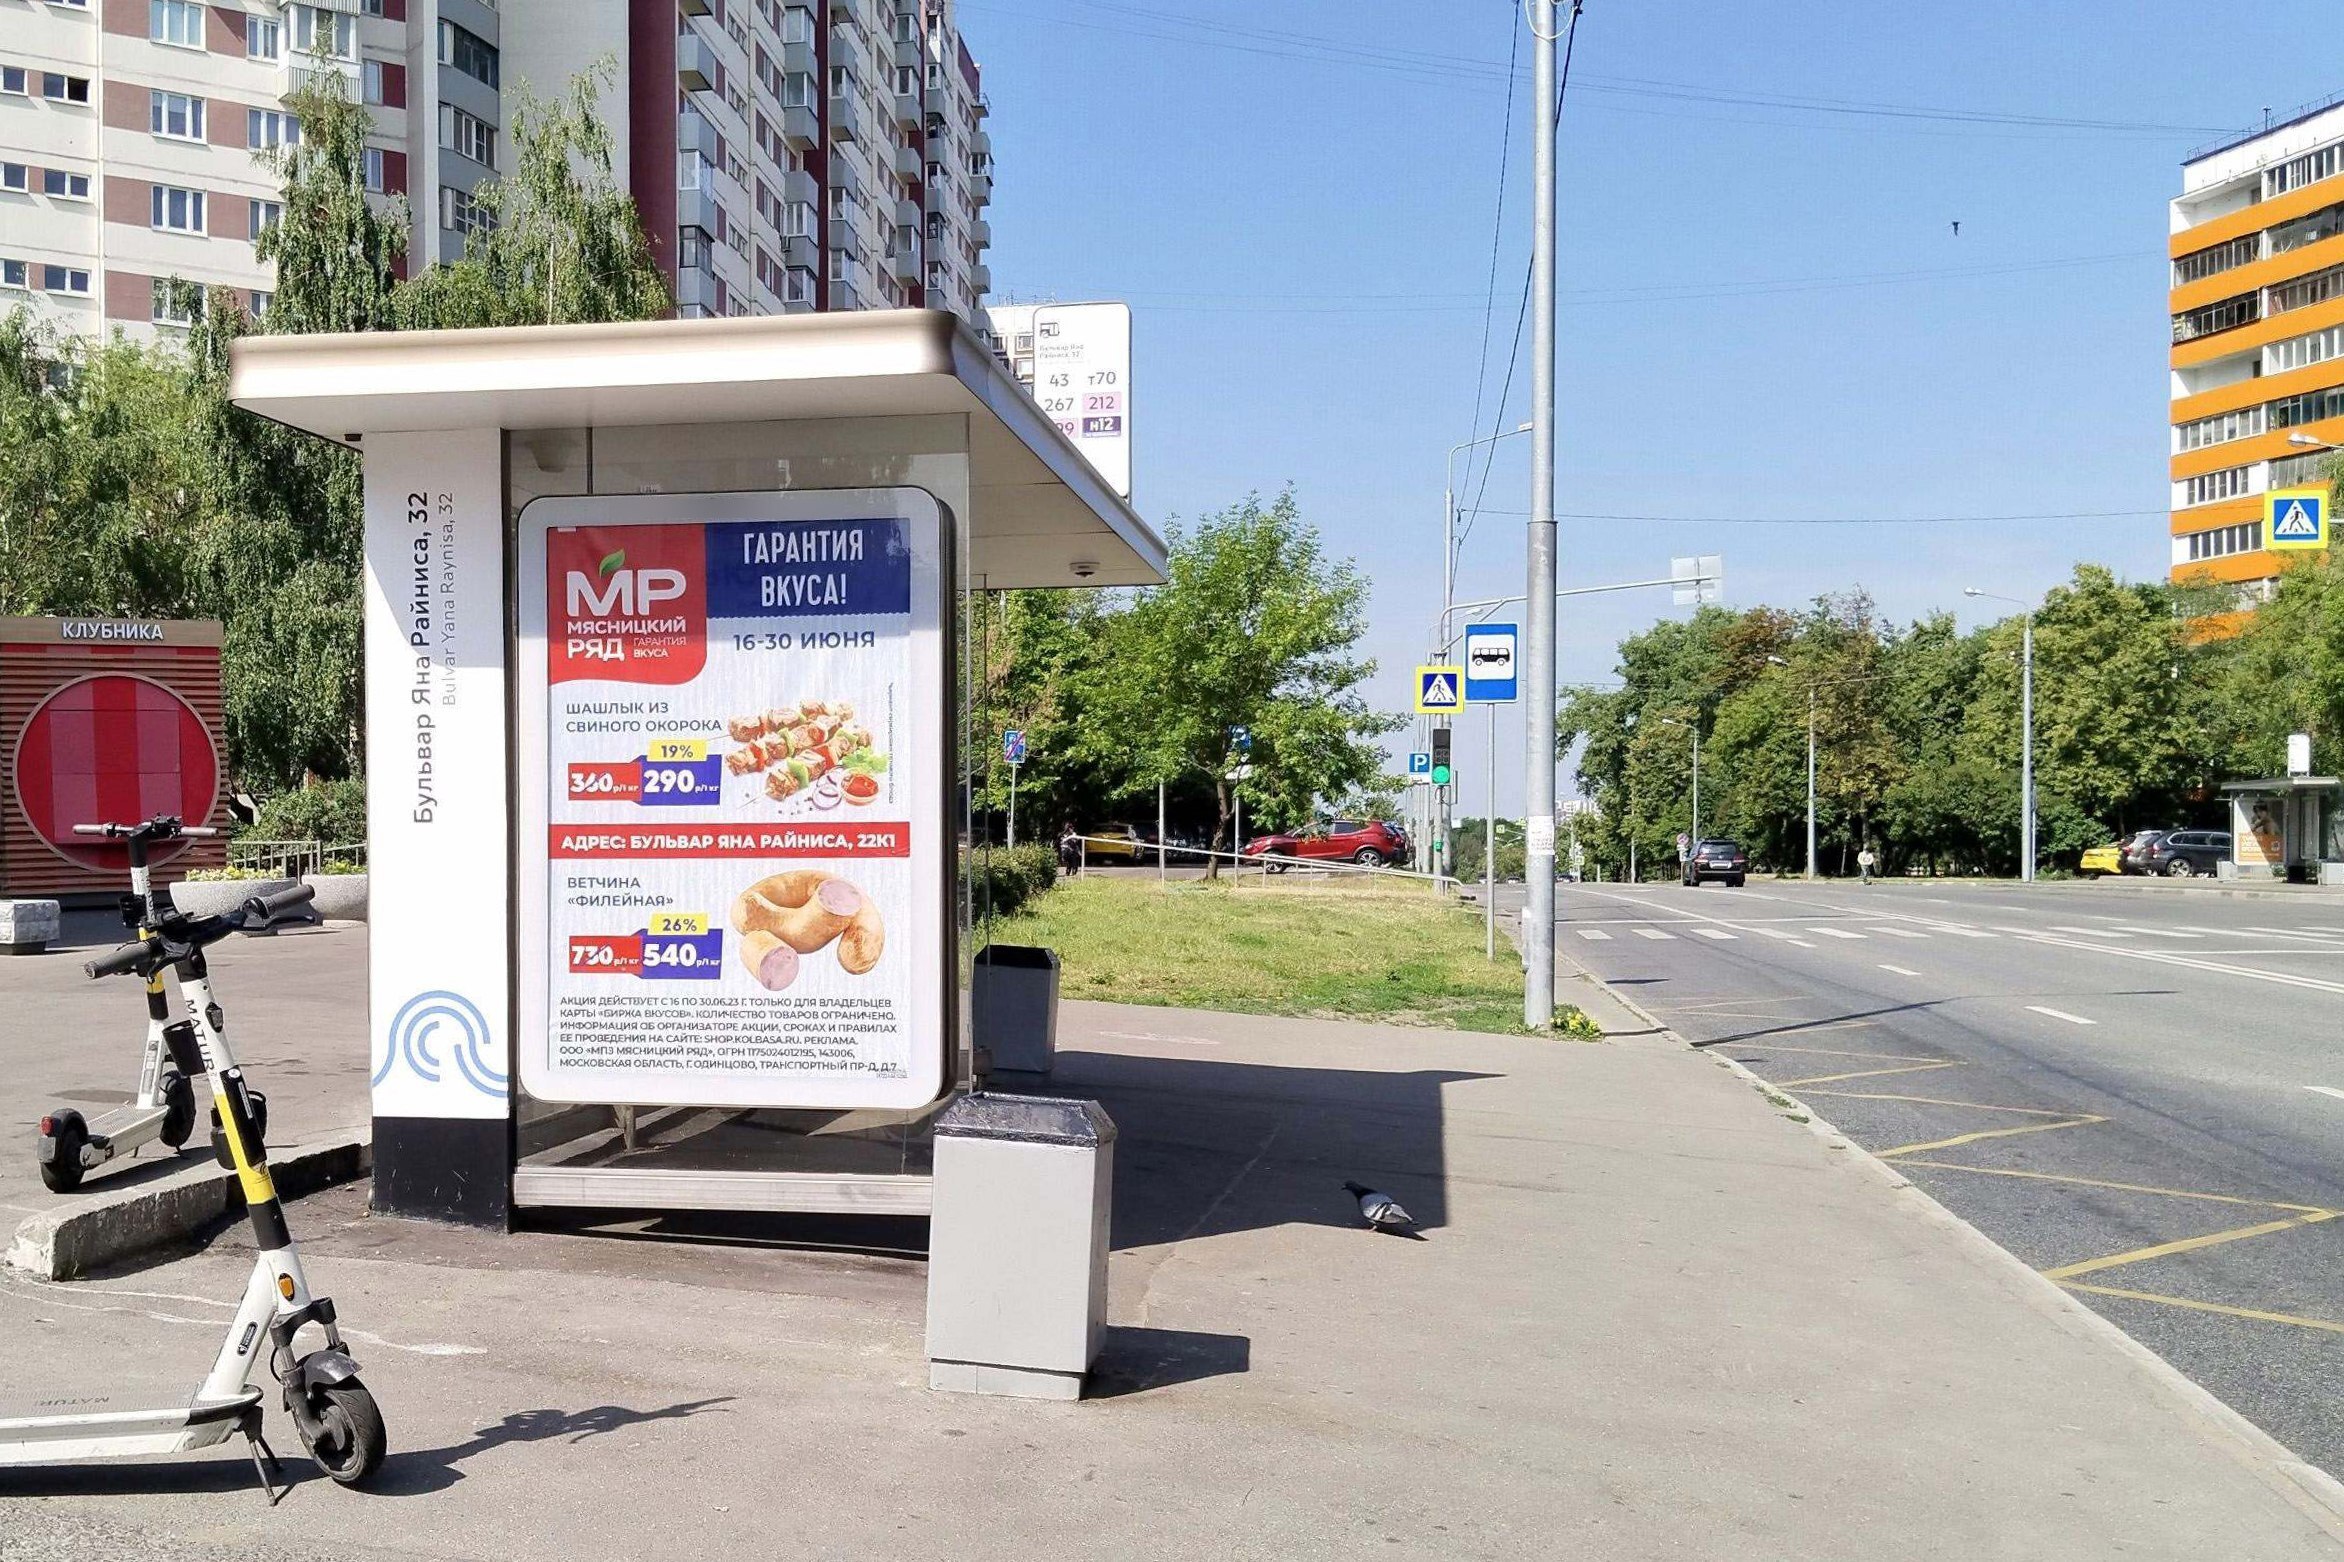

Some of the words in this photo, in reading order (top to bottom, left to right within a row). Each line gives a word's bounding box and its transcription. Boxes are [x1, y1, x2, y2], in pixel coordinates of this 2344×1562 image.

[1050, 374, 1069, 387] 43
[1044, 398, 1074, 412] 267
[1090, 396, 1114, 410] 212
[408, 491, 428, 523] 32
[438, 492, 453, 515] 32
[744, 529, 864, 564] ГАРАНТИЯ
[440, 521, 457, 594] Raynisa,
[409, 530, 433, 647] Райниса,
[760, 573, 848, 608] ВКУСА!
[62, 621, 164, 641] КЛУБНИКА
[441, 599, 456, 644] Yana
[567, 615, 686, 635] МЯСНИЦКИЙ
[567, 638, 626, 662] РЯД
[633, 636, 687, 647] ГАРАНТИЯ
[733, 632, 792, 651] 16-30
[800, 631, 876, 649] ИЮНЯ
[633, 648, 669, 658] ВКУСА
[412, 656, 431, 705] Яна
[442, 649, 456, 706] Bulvar
[566, 702, 645, 716] ШАШЛЫК
[648, 702, 669, 714] ИЗ
[566, 720, 640, 733] СВИНОГО
[645, 719, 722, 732] ОКОРОКА
[660, 744, 694, 759] 19%
[414, 712, 437, 824] Бульвар
[1414, 754, 1428, 772] P
[570, 772, 614, 792] 360
[643, 769, 695, 793] 290
[561, 834, 627, 851] АДРЕС:
[630, 834, 713, 850] БУЛЬВАР
[718, 834, 757, 850] ЯНА
[760, 831, 853, 851] РАЙНИСА,
[857, 834, 896, 849] 22К1
[568, 877, 641, 889] ВЕТЧИНА
[568, 892, 674, 908] «ФИЛЕЙНАЯ»
[662, 918, 698, 932] 26%
[571, 944, 614, 966] 730
[642, 942, 697, 967] 540
[560, 996, 596, 1006] АКЦИЯ
[598, 995, 658, 1007] ДЕЙСТВУЕТ
[660, 997, 668, 1006] С
[670, 998, 679, 1006] 16
[682, 998, 698, 1006] ПО
[700, 998, 740, 1007] 30.06.23
[750, 998, 792, 1008] ТОЛЬКО
[794, 998, 816, 1008] ДЛЯ
[820, 999, 892, 1009] ВЛАДЕЛЬЦЕВ
[560, 1009, 596, 1018] КАРТЫ
[696, 1010, 766, 1019] КОЛИЧЕСТВО
[768, 1010, 819, 1019] ТОВАРОВ
[821, 1011, 896, 1020] ОГРАНИЧЕНО.
[560, 1021, 638, 1031] ИНФОРМАЦИЯ
[640, 1022, 655, 1030] ОБ
[657, 1022, 738, 1031] ОРГАНИЗАТОРЕ
[741, 1023, 782, 1033] АКЦИИ,
[783, 1024, 826, 1032] СРОКАХ
[828, 1024, 836, 1032] И
[838, 1024, 897, 1033] ПРАВИЛАХ
[560, 1034, 573, 1042] ЕЕ
[574, 1034, 646, 1043] ПРОВЕДЕНИЯ
[648, 1034, 664, 1043] НА
[666, 1033, 702, 1043] САЙТЕ:
[804, 1036, 859, 1045] РЕКЛАМА.
[560, 1046, 584, 1055] ООО
[616, 1045, 684, 1056] МЯСНИЦКИЙ
[718, 1048, 746, 1056] ОГРН
[560, 1058, 632, 1068] МОСКОВСКАЯ
[634, 1059, 684, 1069] ОБЛАСТЬ,
[760, 1060, 848, 1070] ТРАНСПОРТНЫЙ
